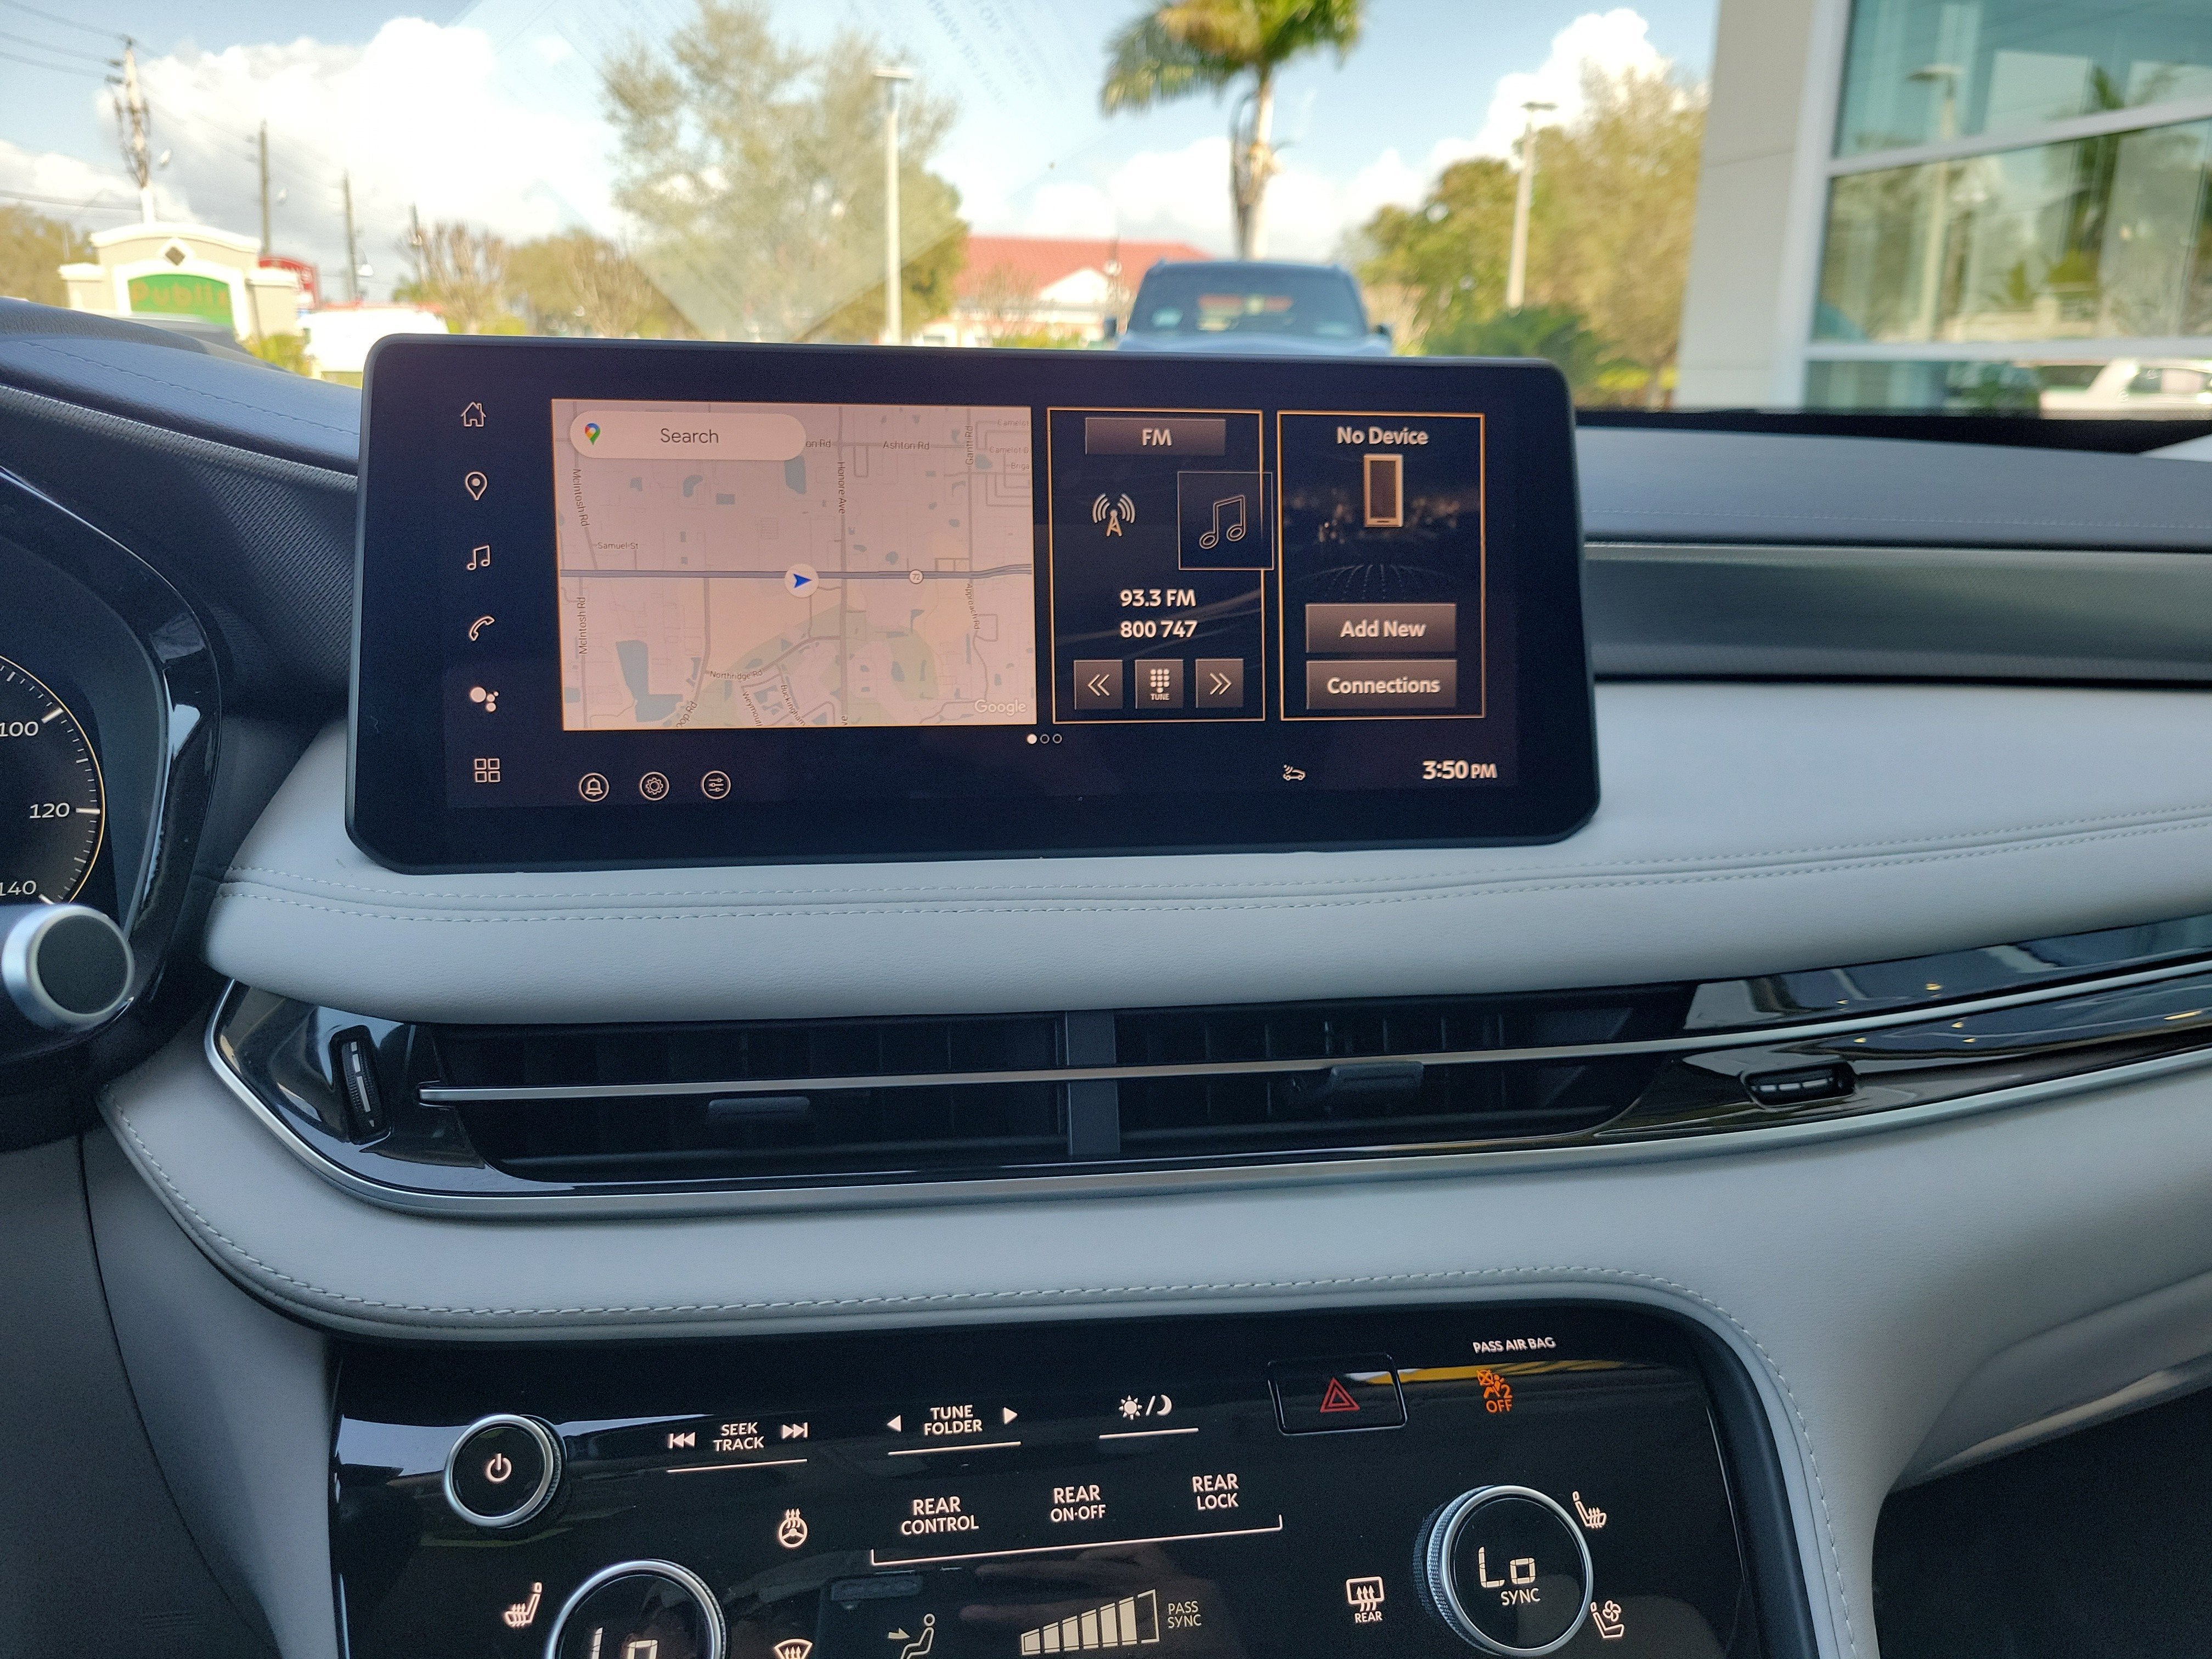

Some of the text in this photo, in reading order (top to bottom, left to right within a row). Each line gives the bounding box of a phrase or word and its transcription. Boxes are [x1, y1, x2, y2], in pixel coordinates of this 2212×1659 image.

[660, 428, 719, 443] Search
[964, 426, 974, 438] Rd
[1141, 428, 1172, 446] FM
[1336, 426, 1429, 445] No Device
[819, 439, 831, 448] Rd
[882, 441, 930, 450] Ashton Rd
[837, 461, 847, 515] Honore Ave
[572, 469, 590, 527] McIntosh Rd
[597, 541, 628, 550] Samuel
[964, 583, 981, 630] Approach Rd
[1120, 589, 1197, 607] 93.3 FM
[576, 597, 588, 654] McIntosh Rd
[1120, 620, 1198, 638] 800 747
[1340, 619, 1426, 638] Add New
[710, 670, 751, 681] Northridge
[1327, 676, 1441, 694] Connections
[781, 685, 806, 726] Buckingham
[1150, 693, 1170, 701] TUNE
[686, 701, 698, 714] Rd
[974, 699, 1027, 716] Google
[0, 721, 39, 737] 100
[1423, 759, 1499, 780] 3:50 PM
[29, 802, 70, 819] 120
[0, 880, 37, 896] 140
[1472, 1336, 1557, 1354] PASS AIR BAG
[929, 1404, 974, 1420] TUNE
[1486, 1398, 1513, 1414] OFF
[720, 1421, 758, 1437] SEEK
[923, 1419, 983, 1436] FOLDER
[713, 1436, 764, 1452] TRACK
[1191, 1472, 1239, 1493] REAR
[1053, 1485, 1102, 1504] REAR
[1195, 1492, 1240, 1511] LOCK
[912, 1496, 962, 1516] REAR
[900, 1514, 980, 1536] CONTROL
[1479, 1547, 1536, 1588] Lo
[1500, 1588, 1541, 1606] SYNC
[1167, 1600, 1200, 1615] PASS
[1167, 1612, 1203, 1629] SYNC
[1355, 1611, 1383, 1623] REAR
